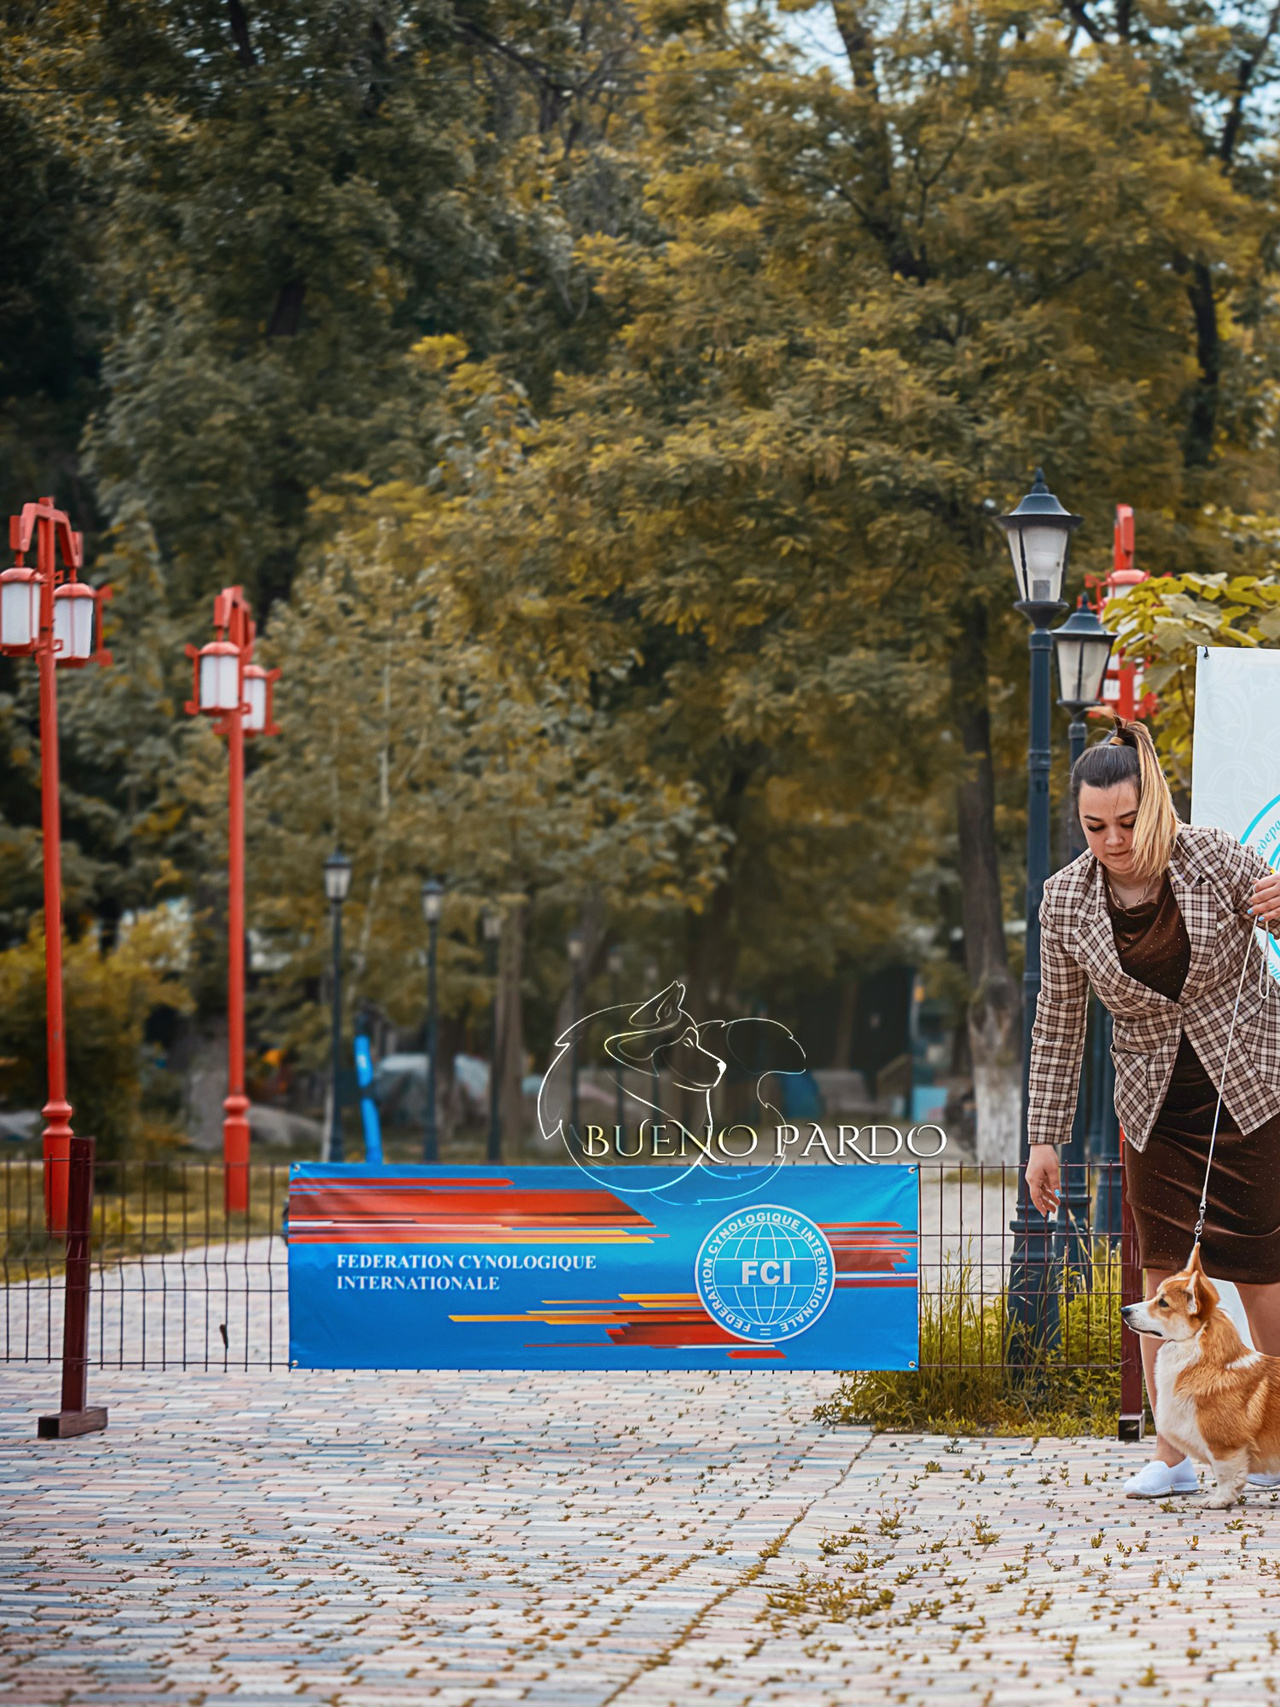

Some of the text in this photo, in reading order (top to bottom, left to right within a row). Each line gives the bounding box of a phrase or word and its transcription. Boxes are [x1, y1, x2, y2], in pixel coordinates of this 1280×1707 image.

[336, 1253, 597, 1272] FEDERATION CYNOLOGIQUE
[702, 1212, 828, 1333] FEDERATION CYNOLOGIQUE INTERNATIONALE
[741, 1261, 791, 1285] FCI
[336, 1275, 500, 1290] INTERNATIONALE
